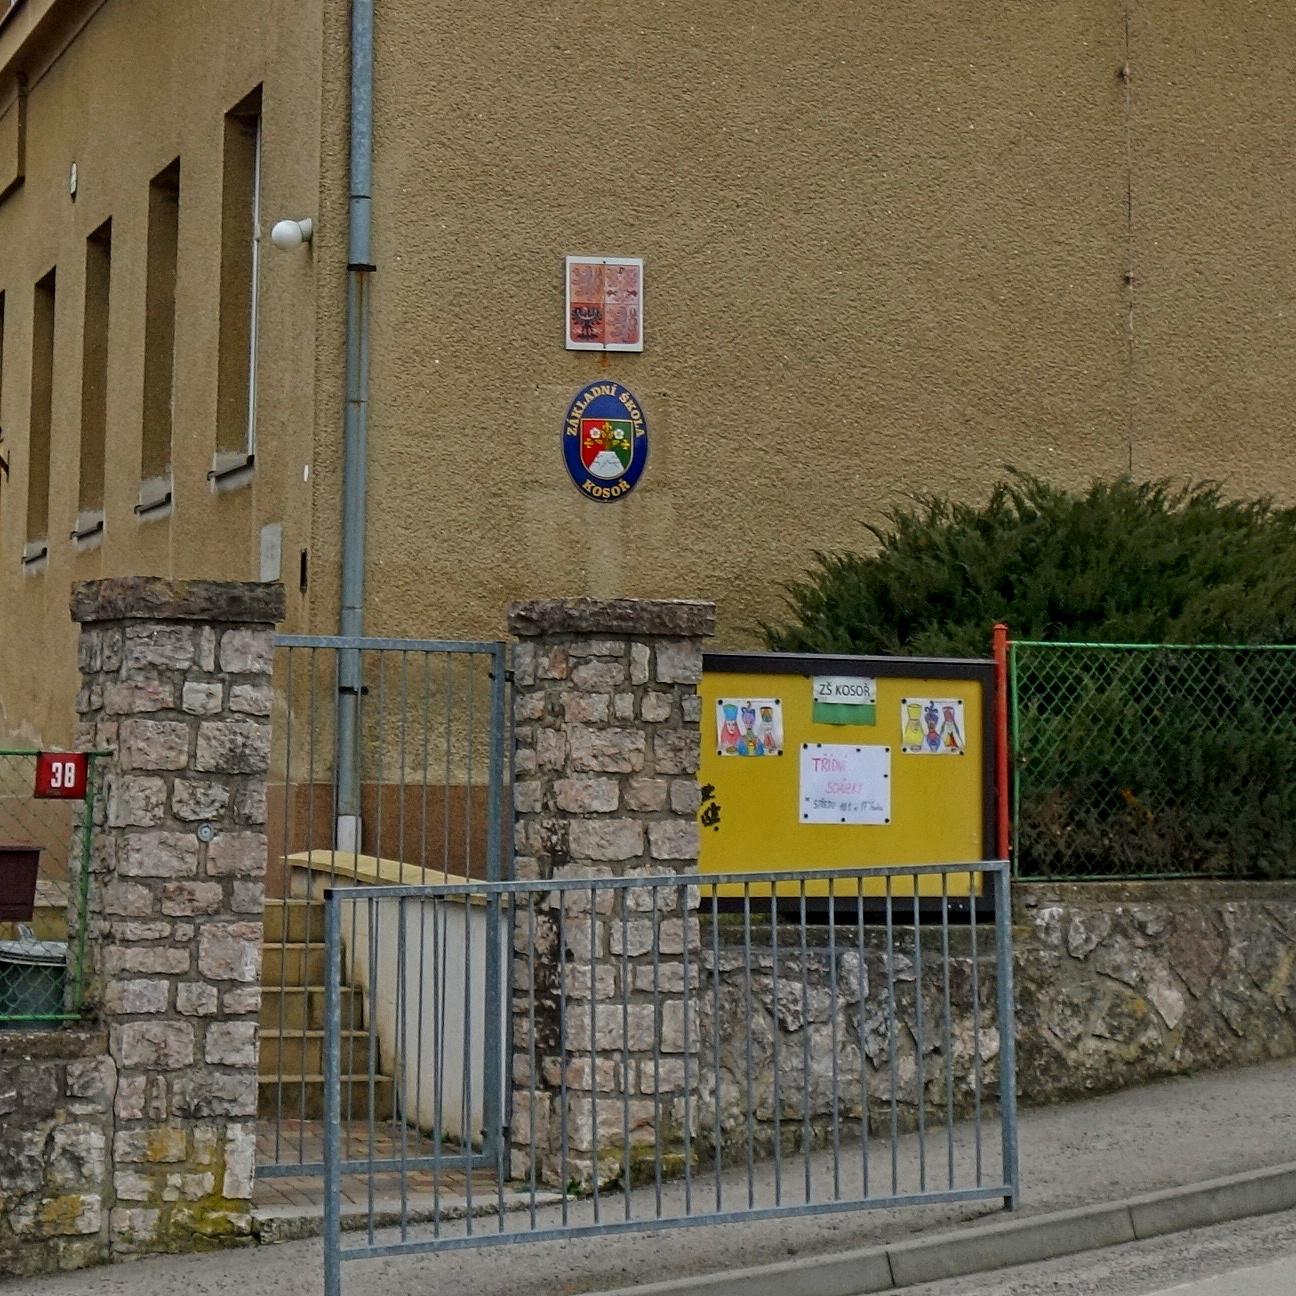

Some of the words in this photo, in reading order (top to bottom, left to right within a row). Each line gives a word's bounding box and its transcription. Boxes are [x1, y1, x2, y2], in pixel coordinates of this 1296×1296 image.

[567, 384, 618, 436] ZÁKLADNÍ
[619, 391, 645, 437] ŠKOLA
[582, 478, 631, 498] KOSOŘ
[819, 681, 832, 695] ZŠ
[835, 682, 870, 696] KOSOŘ
[50, 762, 75, 788] 38
